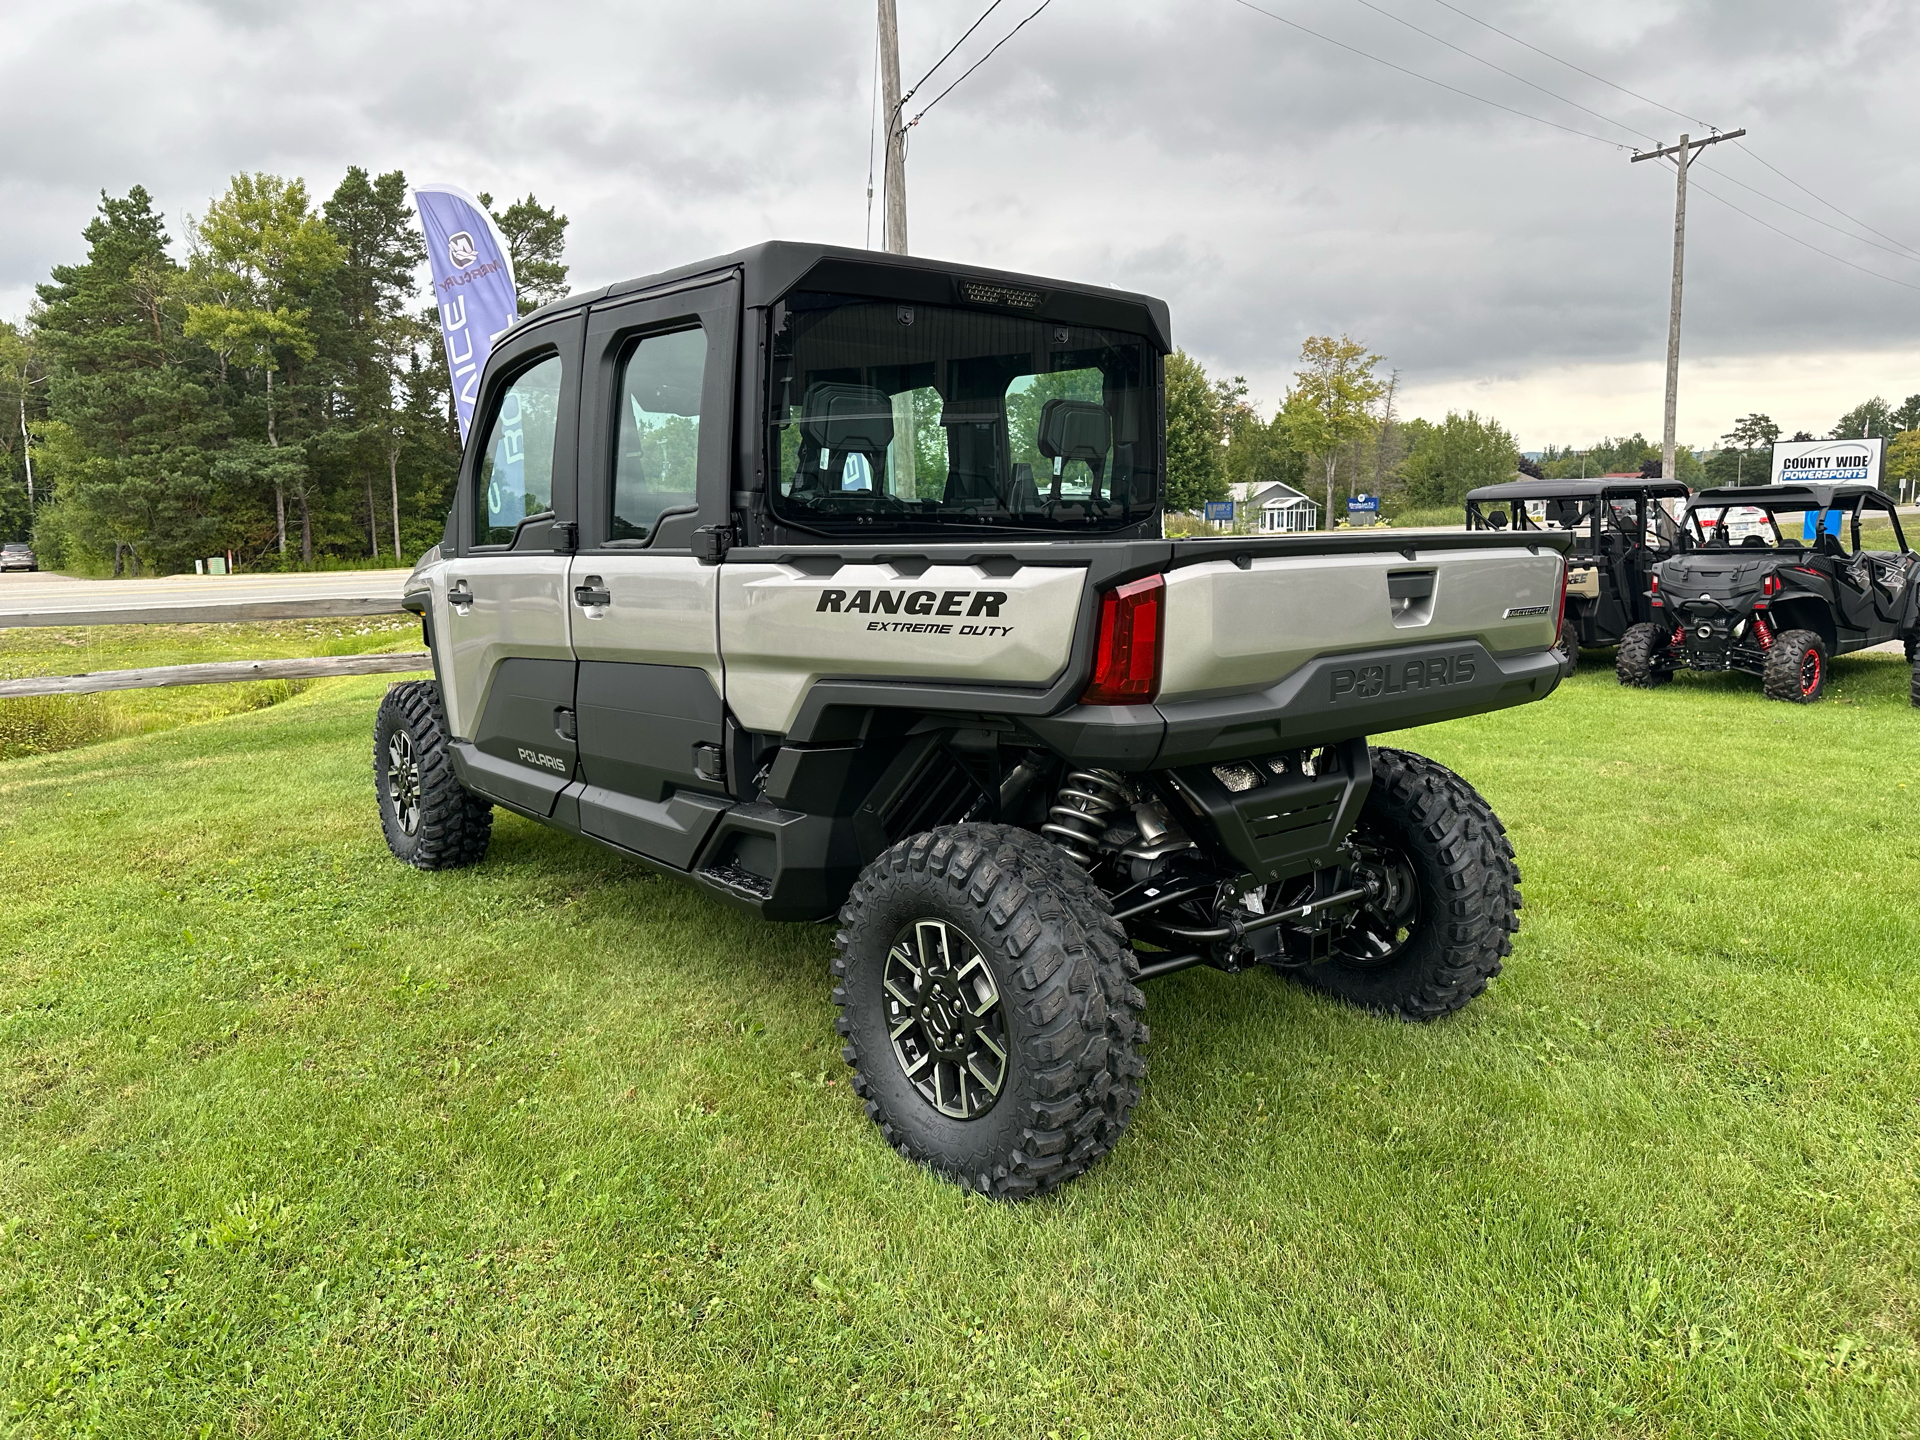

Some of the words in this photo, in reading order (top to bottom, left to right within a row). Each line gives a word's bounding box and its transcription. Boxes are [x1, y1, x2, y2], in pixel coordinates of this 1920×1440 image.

[1783, 456, 1831, 470] COUNTY
[1836, 455, 1869, 468] WIDE
[1783, 469, 1867, 480] POWERSPORTS
[815, 589, 1008, 618] RANGER
[866, 621, 954, 635] EXTREME
[958, 625, 1015, 637] DUTY
[1329, 653, 1476, 704] POLARIS
[517, 747, 566, 772] POLARIS
